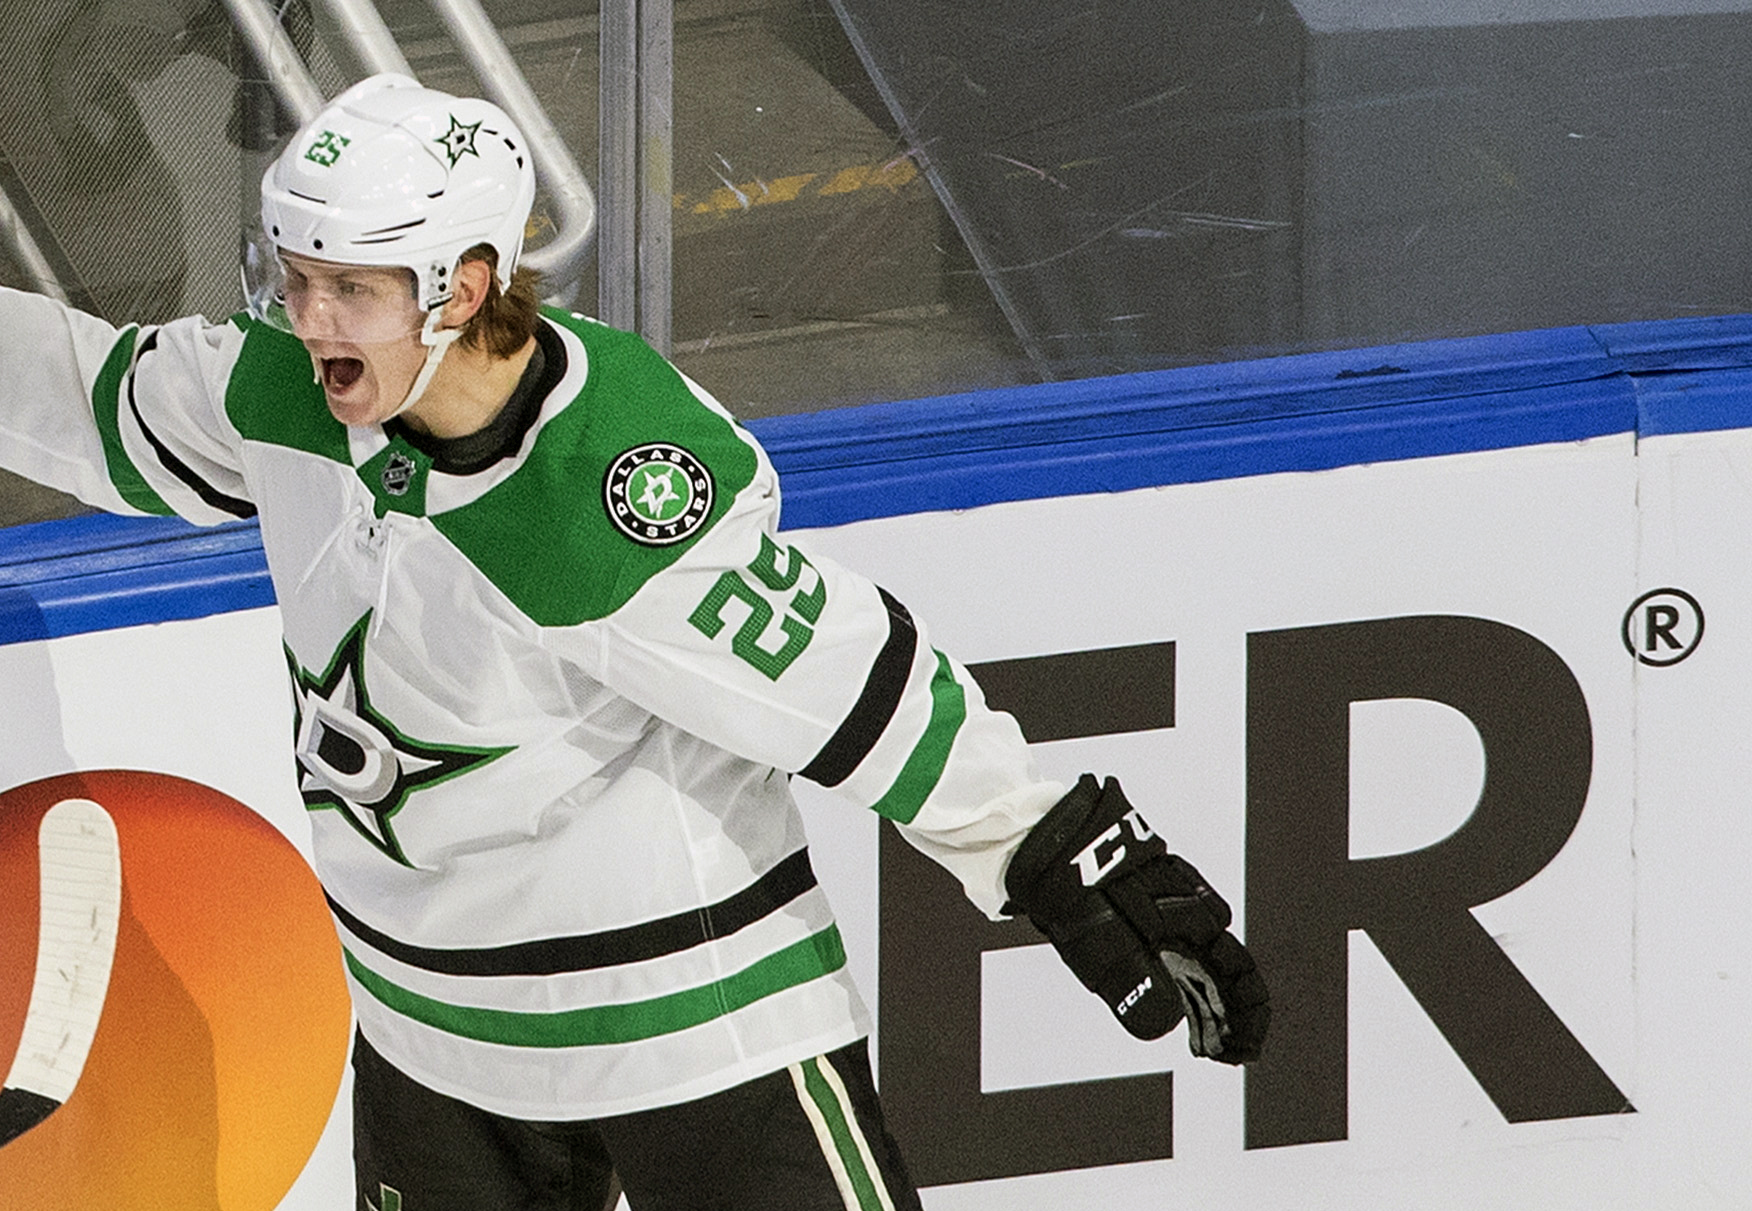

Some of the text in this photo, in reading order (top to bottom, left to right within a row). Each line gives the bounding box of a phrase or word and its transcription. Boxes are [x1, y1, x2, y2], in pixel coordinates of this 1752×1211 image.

[304, 130, 351, 168] 25
[612, 449, 682, 517] DALLAS
[645, 478, 706, 538] STARS
[687, 530, 827, 682] 25
[1116, 976, 1153, 1016] CCM
